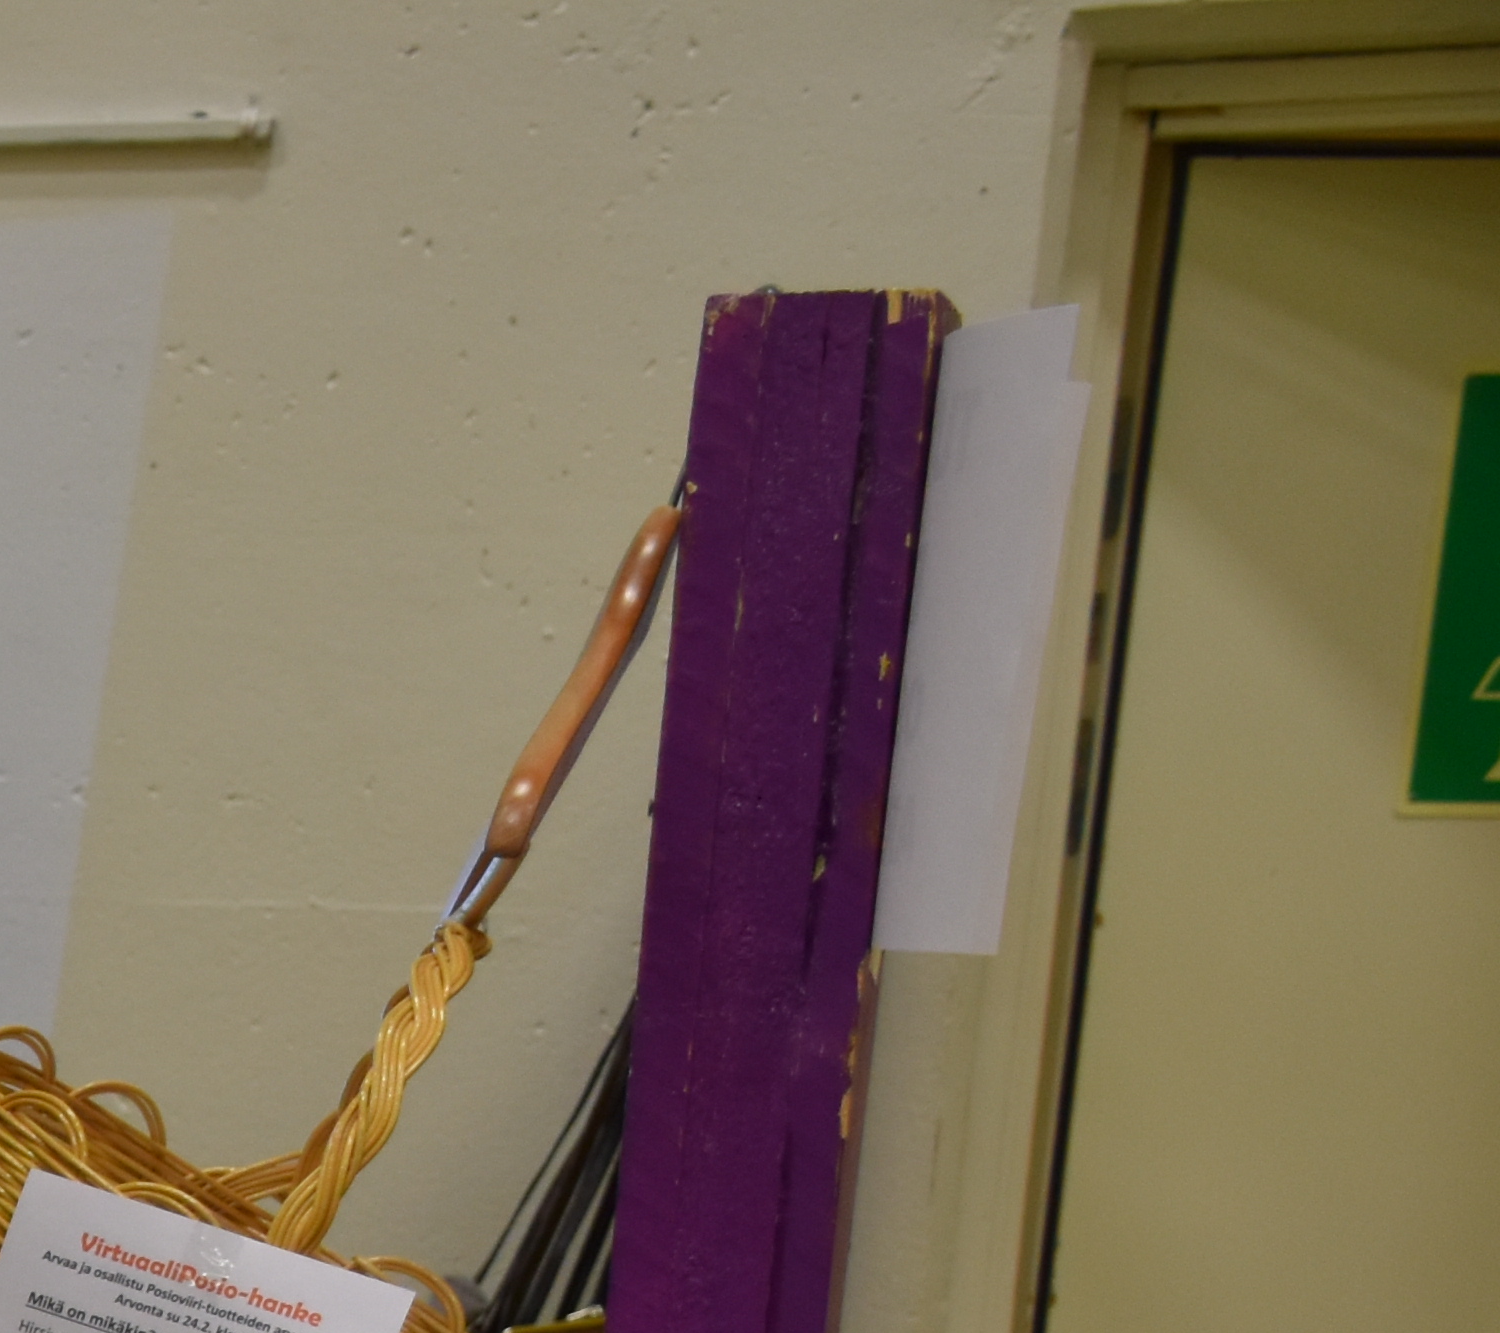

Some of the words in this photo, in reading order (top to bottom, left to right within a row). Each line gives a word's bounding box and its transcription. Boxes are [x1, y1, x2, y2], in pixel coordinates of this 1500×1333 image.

[26, 1290, 65, 1315] Mikä
[67, 1306, 86, 1322] on
[42, 1250, 77, 1271] Arvaa
[78, 1261, 92, 1275] ja
[93, 1267, 144, 1292] osallistu
[146, 1282, 271, 1333] Posioviiri-tuotteiden
[80, 1231, 323, 1327] VirtuaaliPosio-hanke
[115, 1293, 164, 1319] Arvonta
[166, 1312, 181, 1324] su
